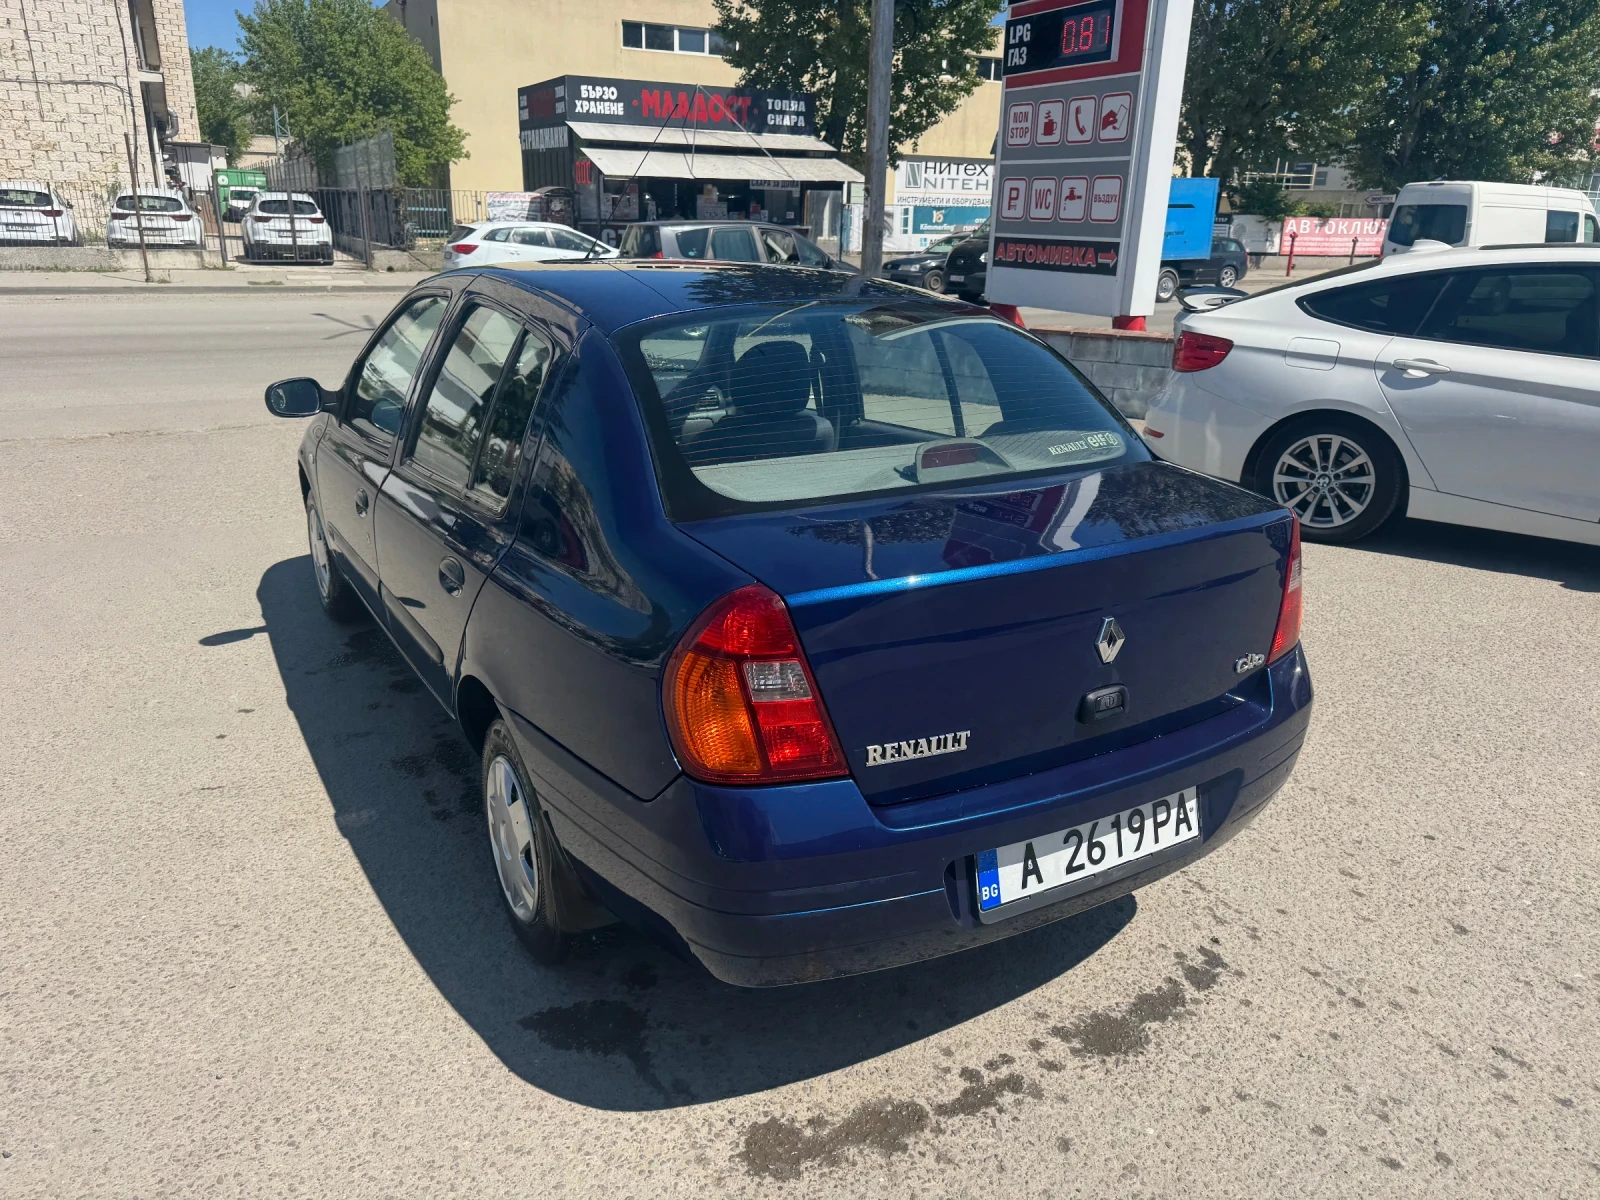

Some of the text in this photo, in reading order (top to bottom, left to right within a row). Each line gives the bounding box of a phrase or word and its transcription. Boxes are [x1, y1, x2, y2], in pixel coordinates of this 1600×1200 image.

[1009, 23, 1031, 44] LPG
[1062, 15, 1110, 54] 0.81
[1008, 47, 1027, 66] ГАЗ
[580, 85, 618, 100] БЪРЗО
[575, 100, 624, 115] ХРАНЕНЕ
[641, 89, 752, 124] МЛАДОСТ
[766, 98, 806, 112] ТОПЛА
[767, 114, 806, 127] СКАРА
[1013, 111, 1029, 123] NON
[1010, 127, 1029, 139] STOP
[923, 177, 989, 191] NITEH
[897, 196, 944, 205] ИНСТРУМЕНТИ
[952, 198, 991, 207] ОБОРУДВАН
[1035, 188, 1051, 210] WC
[1093, 194, 1119, 204] ВЪЗДУХ
[995, 243, 1097, 268] АВТОМИВКА
[1048, 440, 1088, 456] RENAULT
[866, 730, 971, 767] RENAULT
[1021, 842, 1044, 890] A
[982, 884, 999, 901] BG
